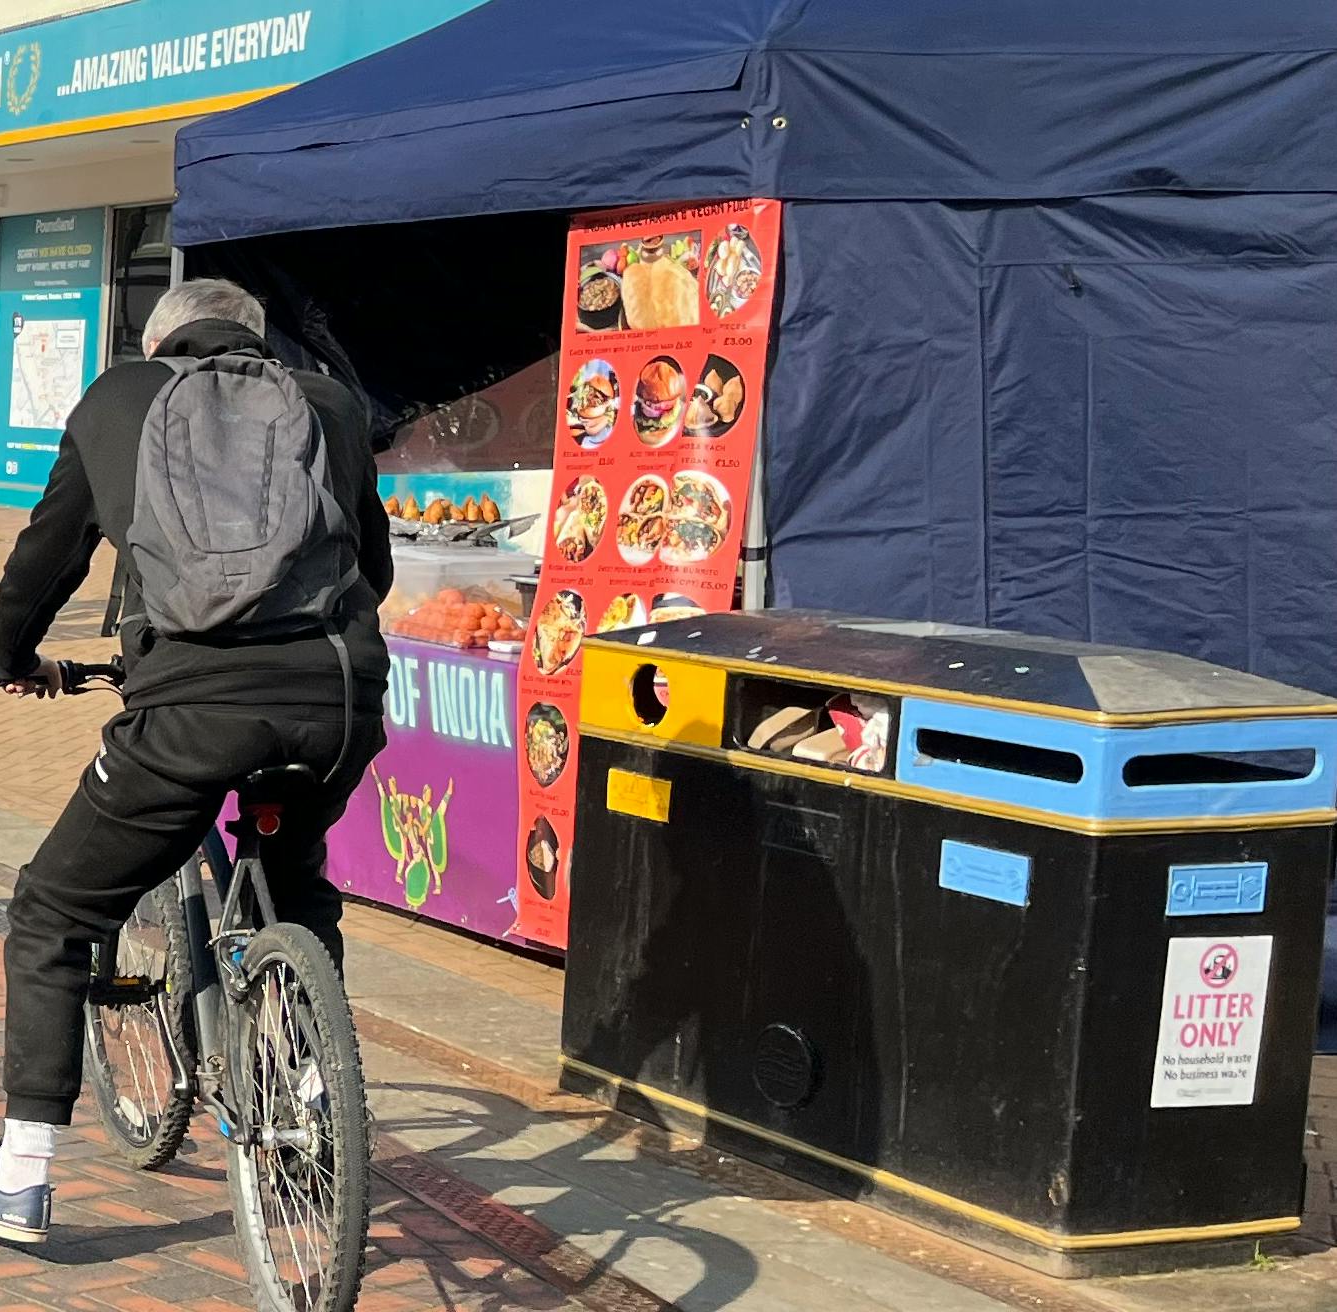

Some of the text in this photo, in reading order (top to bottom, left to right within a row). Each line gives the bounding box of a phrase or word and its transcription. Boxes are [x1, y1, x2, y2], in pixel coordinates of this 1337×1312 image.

[151, 35, 207, 79] VALUE
[210, 10, 312, 65] EVERYDAY
[691, 203, 724, 218] VEGAN
[35, 216, 75, 234] Poundland
[724, 337, 753, 346] £3.00
[700, 582, 728, 591] £5.00
[388, 654, 512, 748] OF INDIA
[1173, 993, 1255, 1020] LITTER
[1180, 1022, 1244, 1048] ONLY
[1162, 1053, 1252, 1066] No household waste
[1164, 1069, 1247, 1080] No business waste
